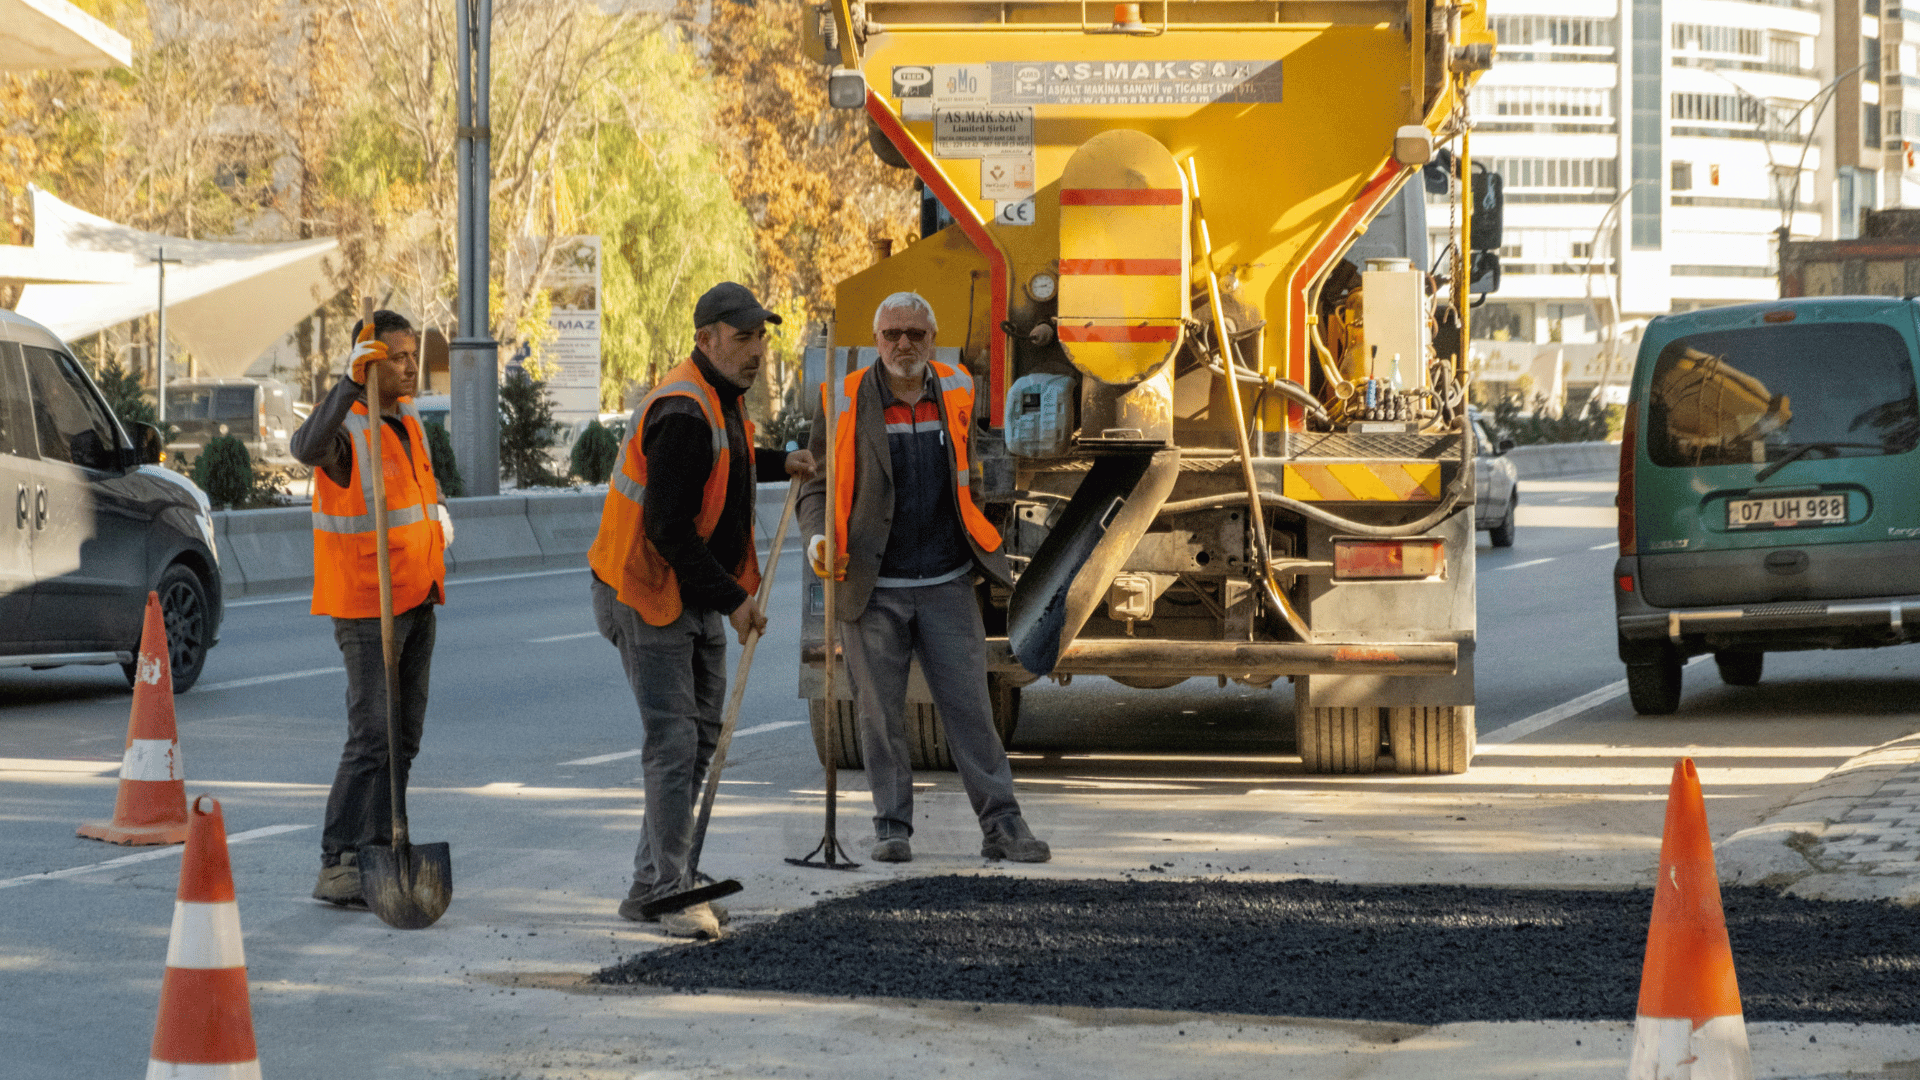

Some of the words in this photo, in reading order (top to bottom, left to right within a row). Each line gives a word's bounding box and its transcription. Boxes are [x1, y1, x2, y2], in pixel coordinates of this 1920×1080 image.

[948, 68, 977, 93] DMO
[1048, 84, 1081, 94] ASFALT
[1084, 82, 1119, 94] MAKİNA
[1162, 86, 1172, 94] ve
[1175, 82, 1215, 94] TİCARET
[1059, 95, 1210, 104] www.asmaksan.com
[945, 111, 1024, 123] AS.MAK.SAN
[952, 125, 985, 133] Limited
[1003, 203, 1027, 221] CE
[1741, 502, 1763, 521] 07
[1773, 500, 1800, 520] UH
[1806, 498, 1841, 518] 988
